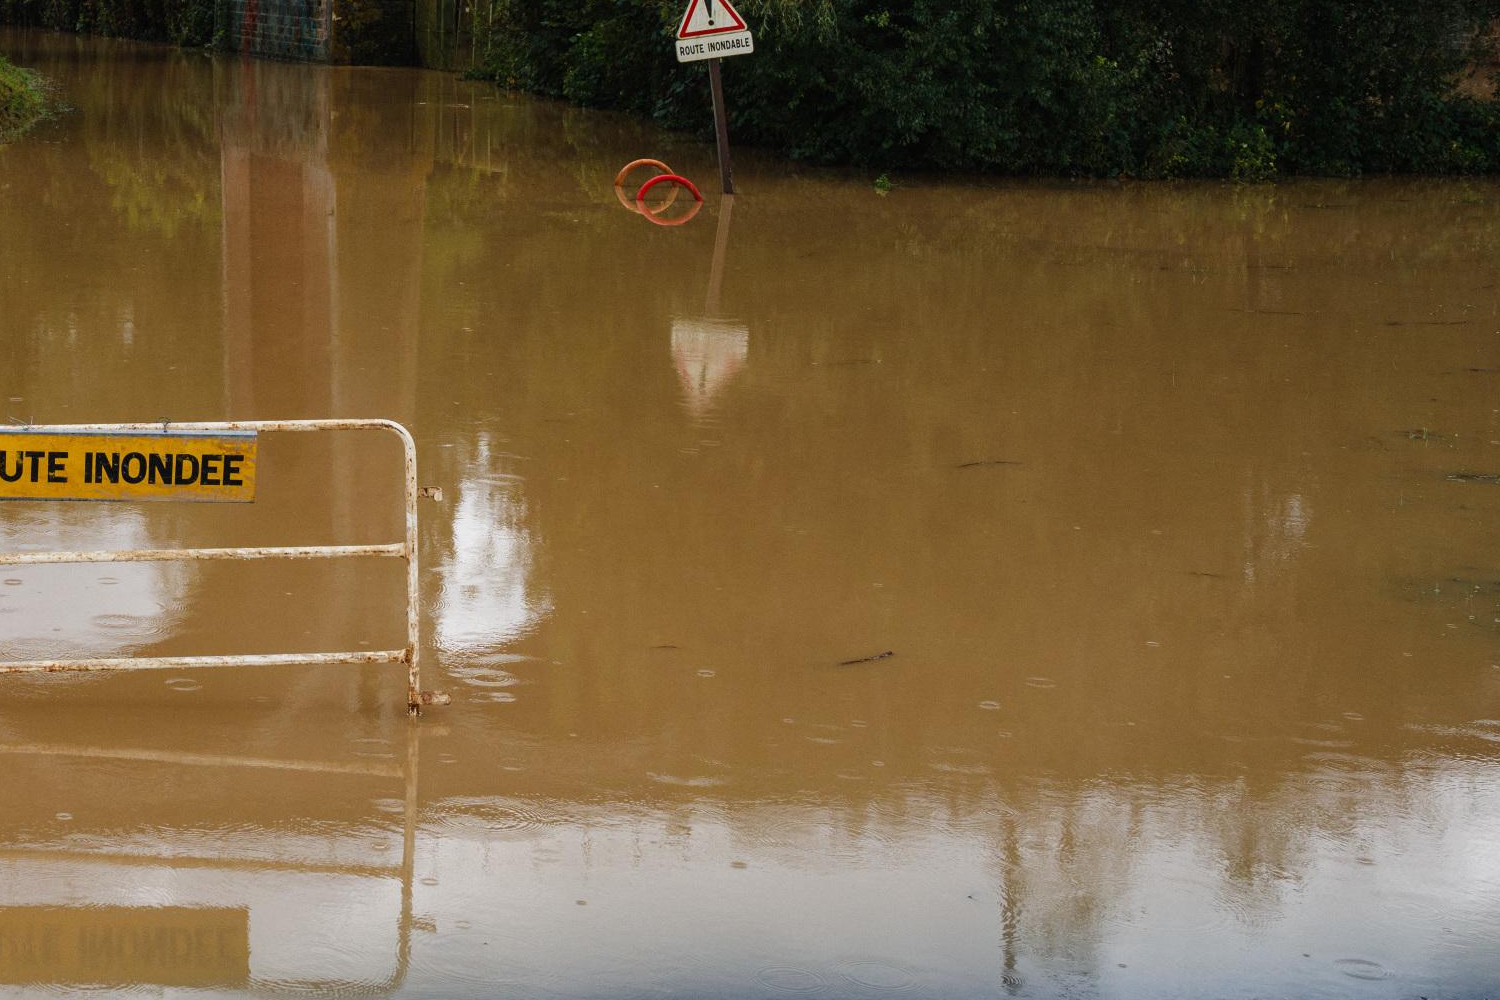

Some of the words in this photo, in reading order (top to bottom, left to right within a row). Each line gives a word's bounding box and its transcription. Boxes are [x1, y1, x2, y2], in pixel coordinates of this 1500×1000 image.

[679, 44, 705, 56] ROUTE
[708, 38, 750, 52] INONDABLE
[84, 452, 244, 486] INONDEE
